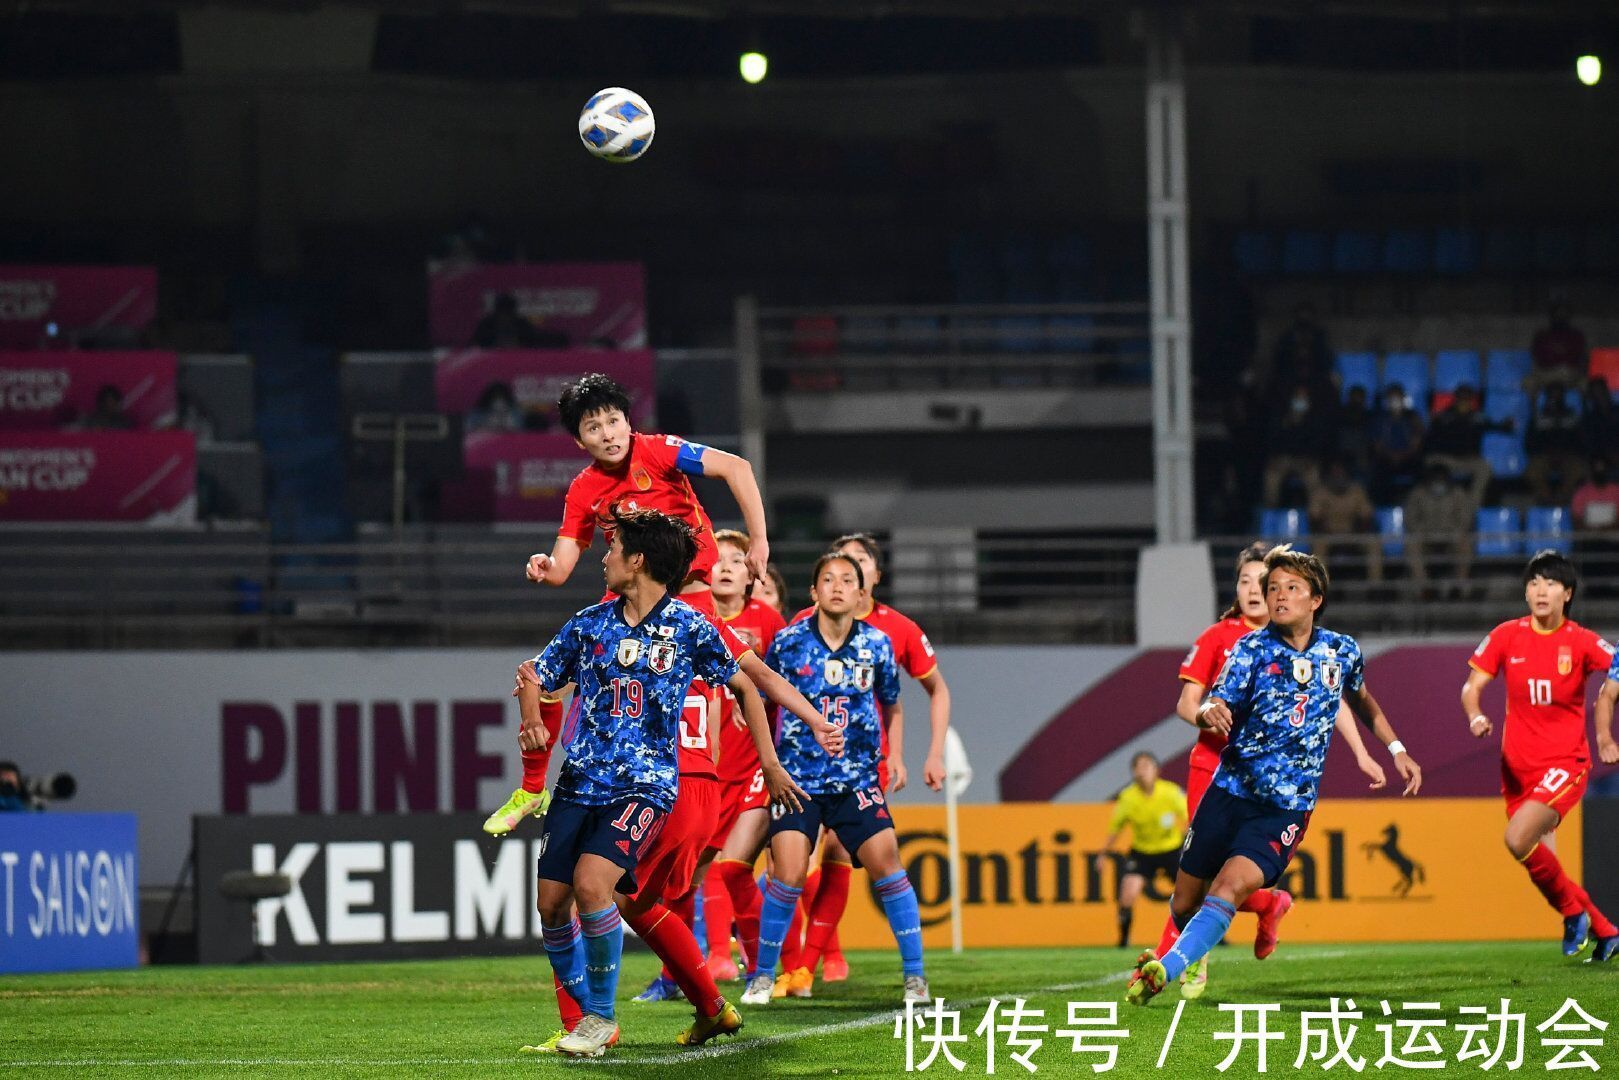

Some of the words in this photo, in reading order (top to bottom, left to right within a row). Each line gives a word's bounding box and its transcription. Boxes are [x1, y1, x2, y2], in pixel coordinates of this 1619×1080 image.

[32, 468, 88, 491] CUP
[610, 678, 643, 718] 19
[1527, 678, 1552, 705] 10
[820, 696, 850, 730] 15
[1289, 694, 1310, 728] 3
[611, 801, 654, 841] 19
[28, 850, 134, 938] SAISON
[252, 838, 541, 946] KELM
